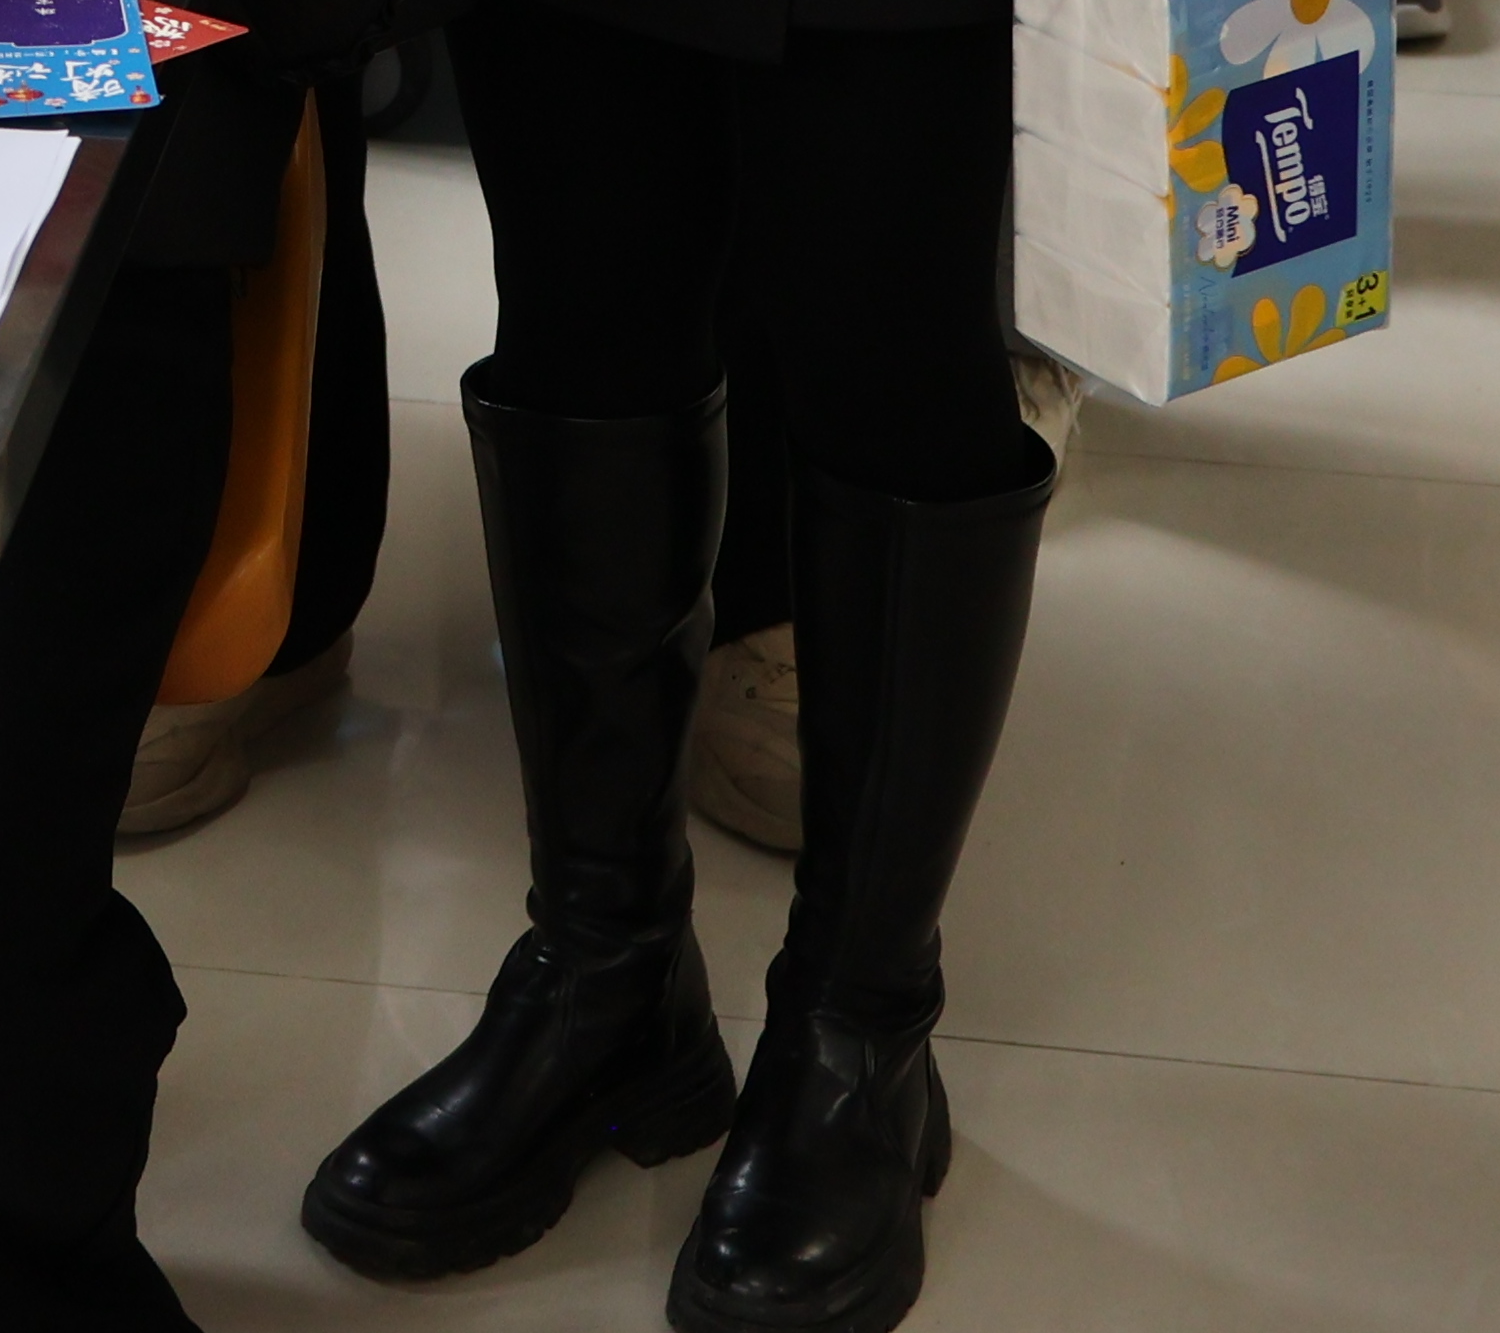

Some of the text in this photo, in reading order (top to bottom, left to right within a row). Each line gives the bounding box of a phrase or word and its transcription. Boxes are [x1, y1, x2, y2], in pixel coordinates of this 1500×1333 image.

[1263, 87, 1314, 227] Tempo
[1307, 174, 1329, 218] 得宝
[1225, 204, 1240, 243] Mini
[1353, 272, 1379, 322] 3+1
